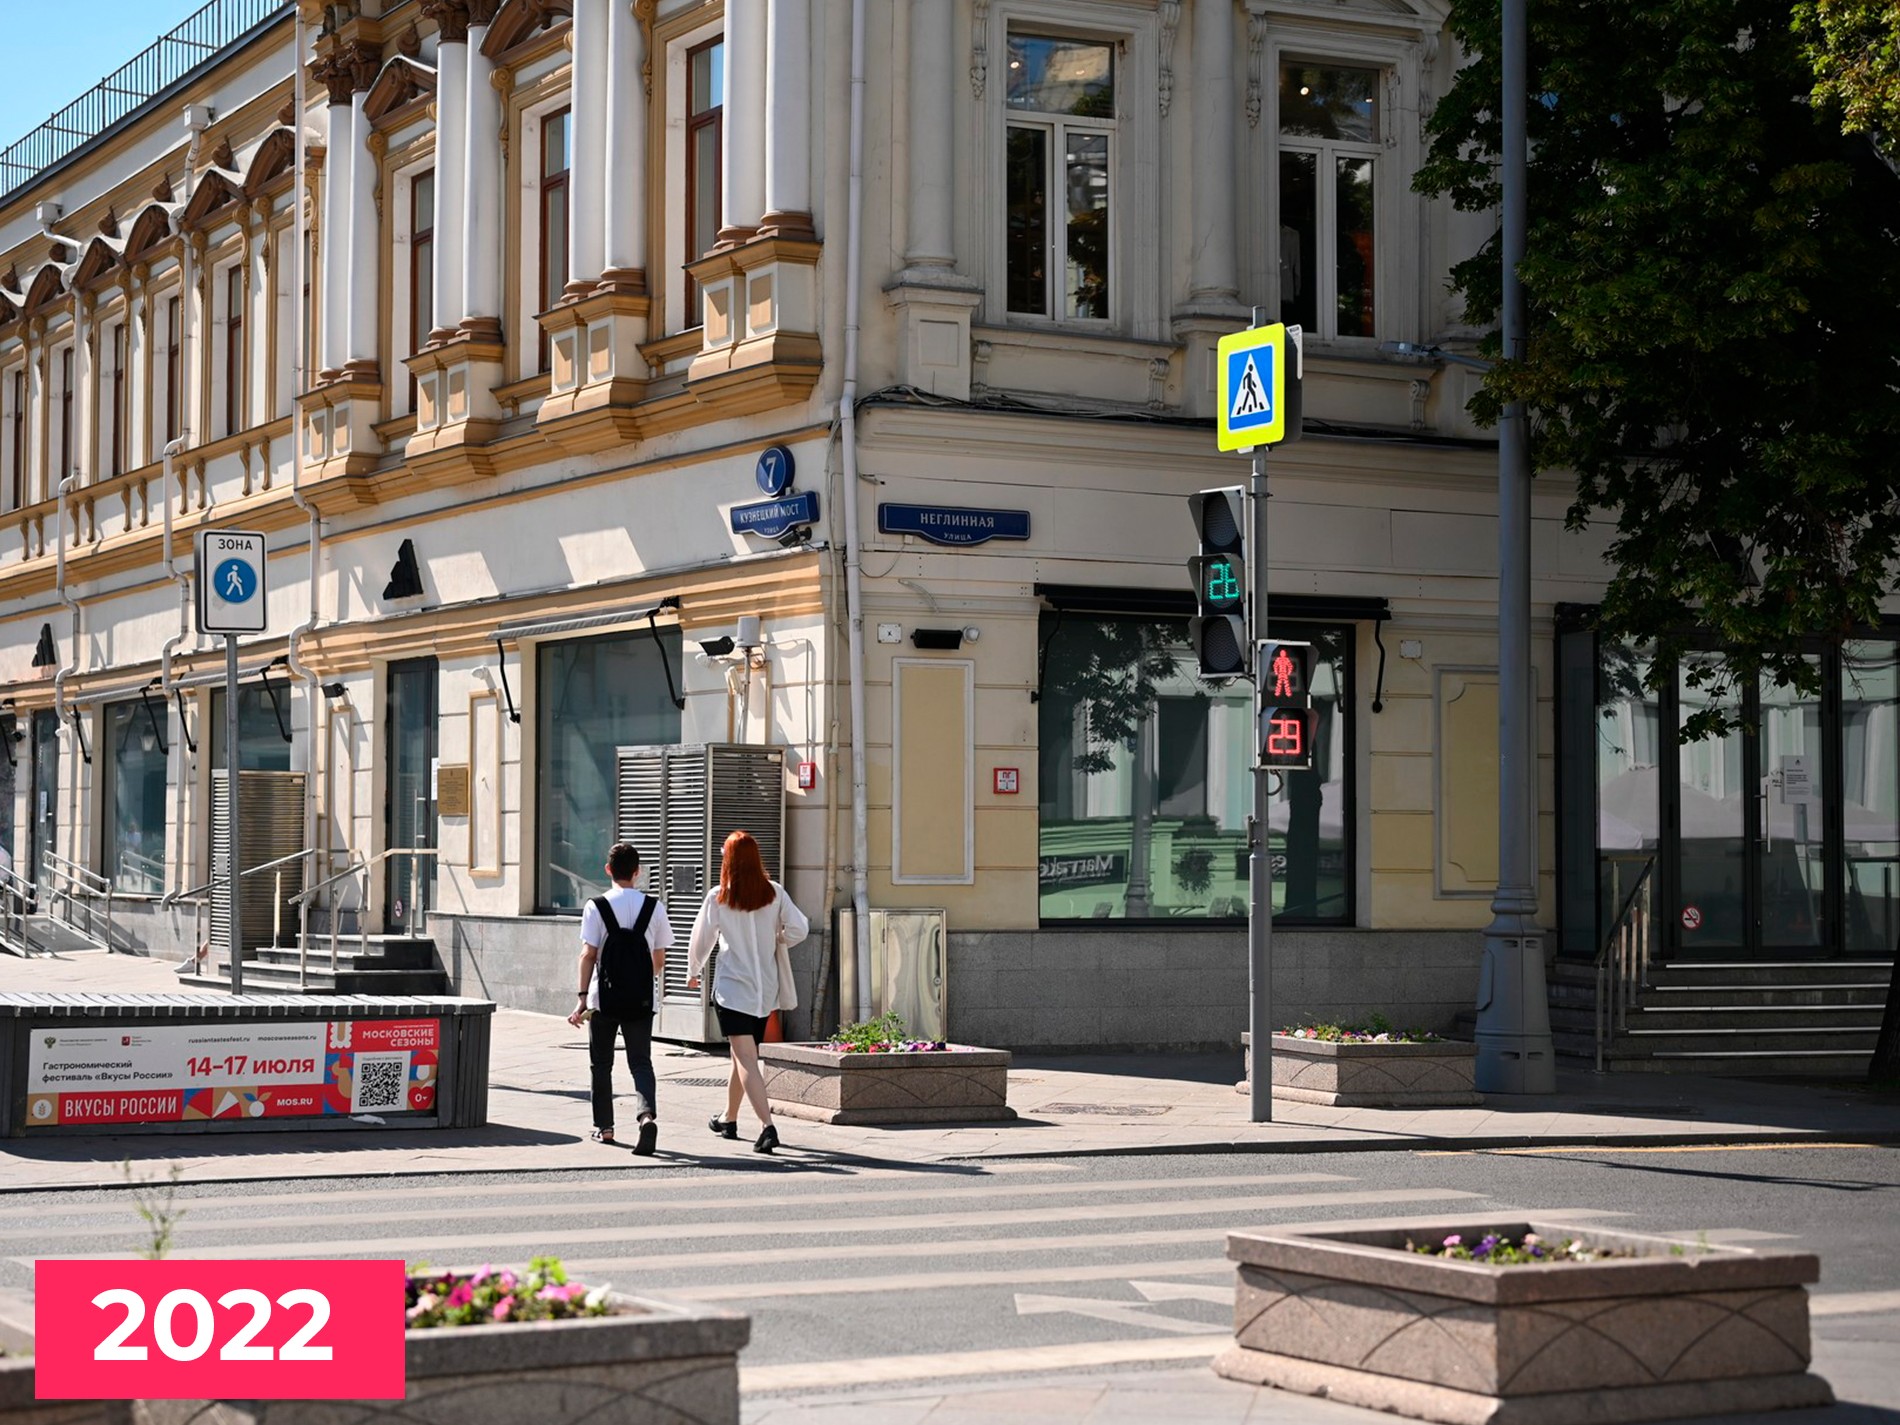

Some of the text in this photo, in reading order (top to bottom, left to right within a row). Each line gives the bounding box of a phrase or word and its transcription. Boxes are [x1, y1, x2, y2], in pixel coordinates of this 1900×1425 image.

[766, 457, 777, 488] 7
[740, 503, 799, 524] КУЗНЕЦКИЙ МОСТ
[920, 513, 995, 528] НЕГЛИННАЯ
[943, 532, 972, 541] УЛИЦА
[218, 538, 253, 551] ЗОНА
[1209, 563, 1240, 600] 26
[1269, 719, 1301, 754] 29
[362, 1028, 434, 1039] МОСКОВСКИЕ
[188, 1036, 251, 1044] russiantastesfest.ru
[390, 1038, 434, 1047] СЕЗОНЫ
[43, 1060, 132, 1072] Гастрономический
[42, 1072, 173, 1084] фестиваль «Вкусы России»
[64, 1096, 177, 1118] ВКУСЫ РОССИИ
[276, 1097, 313, 1106] MOS.RU
